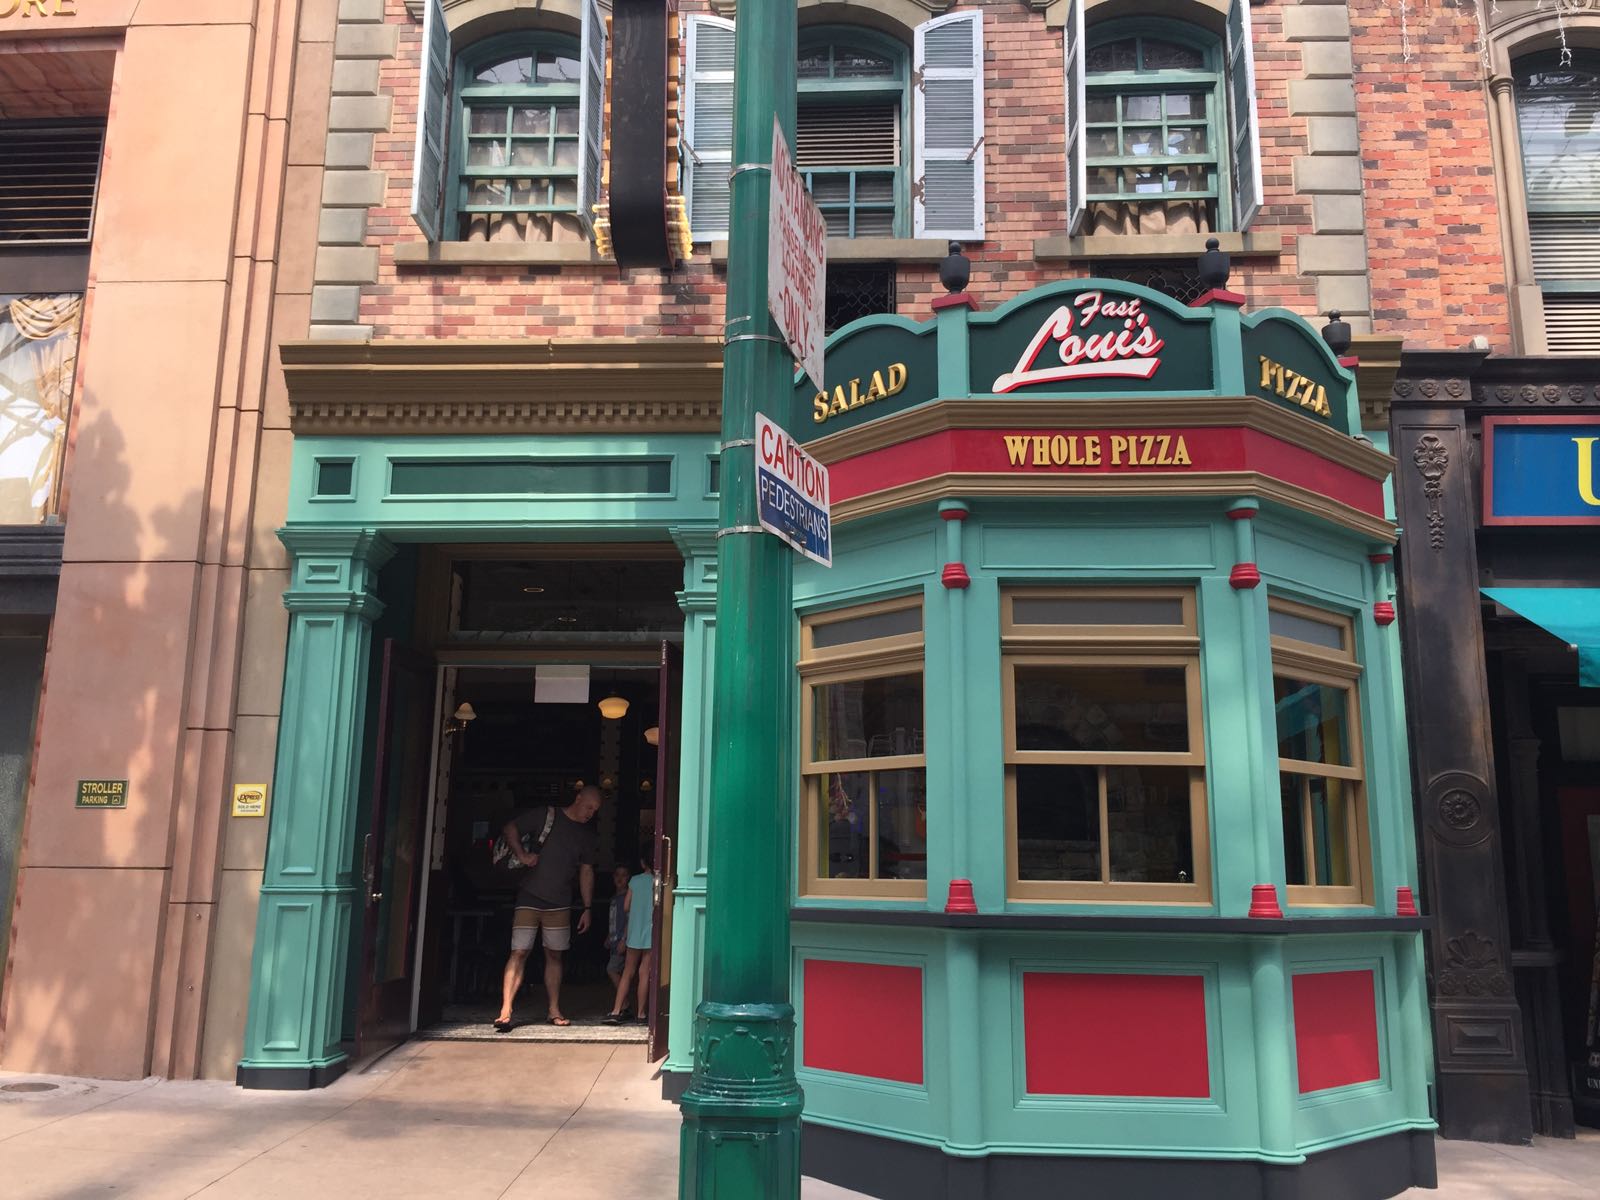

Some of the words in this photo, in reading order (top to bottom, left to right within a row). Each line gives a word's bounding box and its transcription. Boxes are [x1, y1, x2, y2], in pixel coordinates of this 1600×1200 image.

[0, 0, 78, 18] RE
[774, 133, 785, 192] NO
[785, 162, 824, 265] STANDING
[780, 203, 816, 290] PASSENGER
[782, 240, 812, 311] LOADING
[1074, 290, 1141, 327] Fast
[992, 305, 1165, 393] Loui's
[813, 362, 907, 423] SALAD
[1259, 355, 1332, 418] PIZZA
[761, 424, 826, 505] CAUTION
[1003, 434, 1101, 466] WHOLE
[1110, 435, 1193, 466] PIZZA
[761, 474, 828, 541] PEDESTRIANS
[81, 795, 108, 804] PARKING
[82, 783, 123, 793] STROLLER
